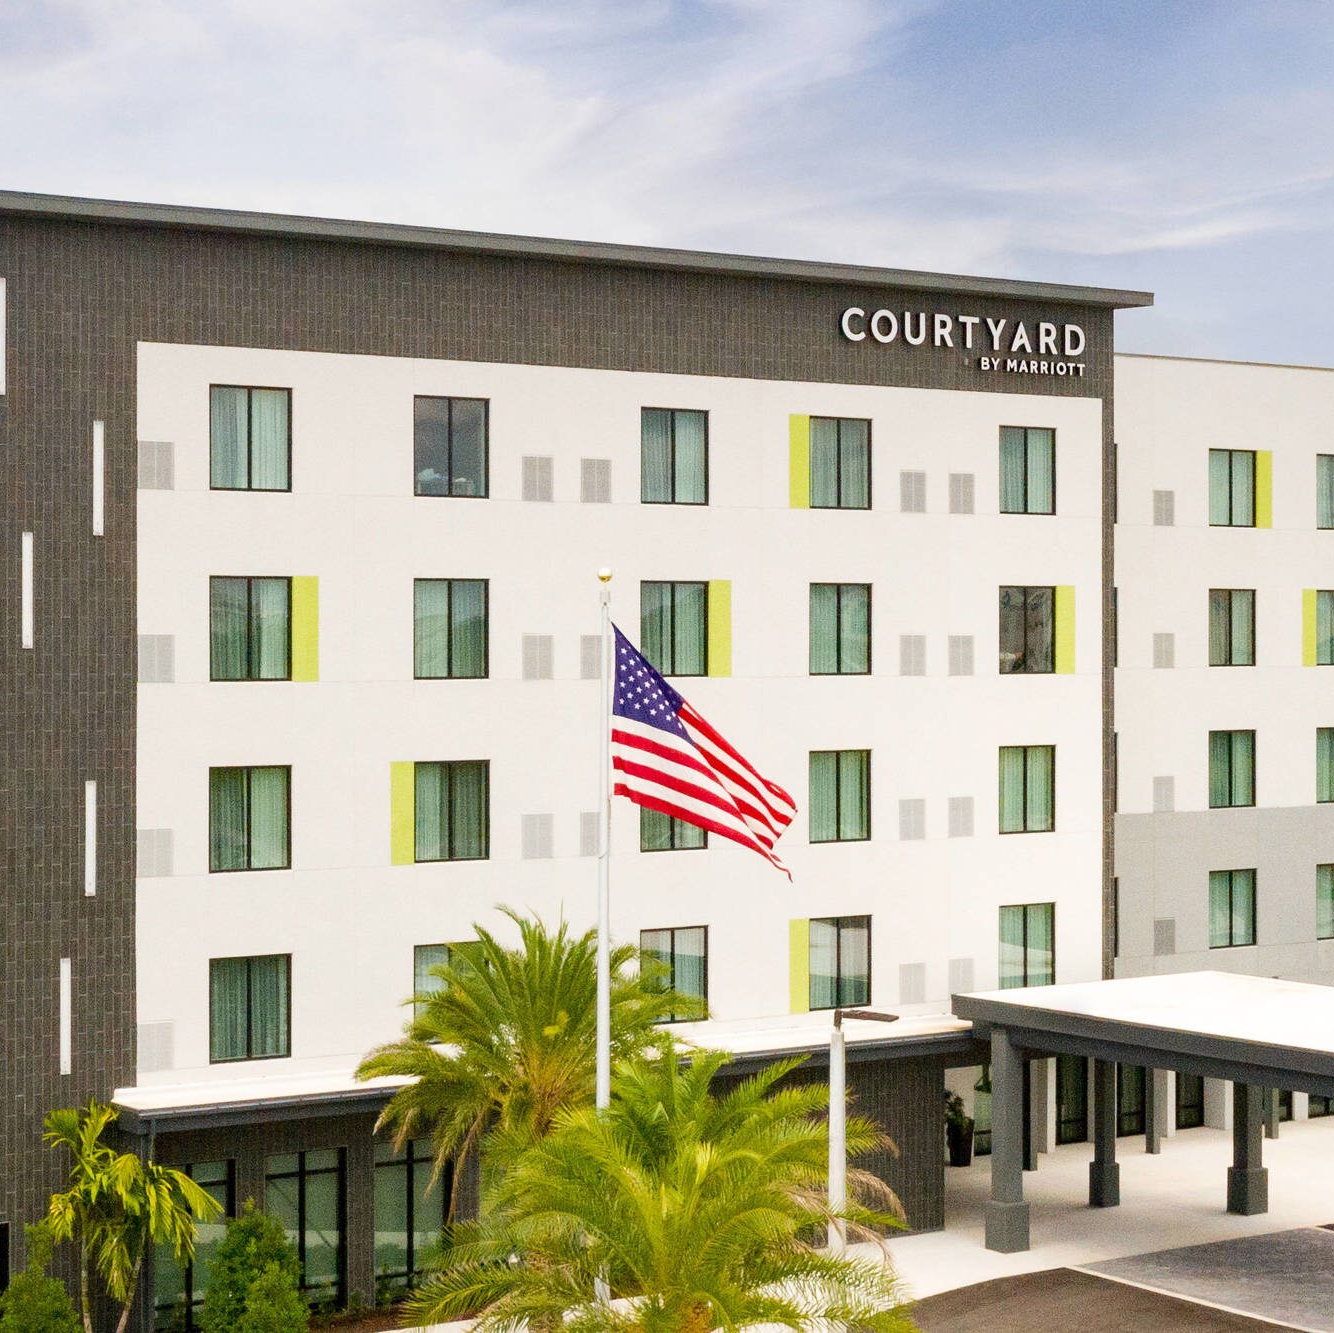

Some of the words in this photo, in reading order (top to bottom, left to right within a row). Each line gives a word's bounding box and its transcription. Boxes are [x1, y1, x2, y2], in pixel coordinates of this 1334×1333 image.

[841, 307, 1086, 356] COURTYARD
[980, 356, 1000, 371] BY
[1006, 358, 1086, 377] MARRIOTT
